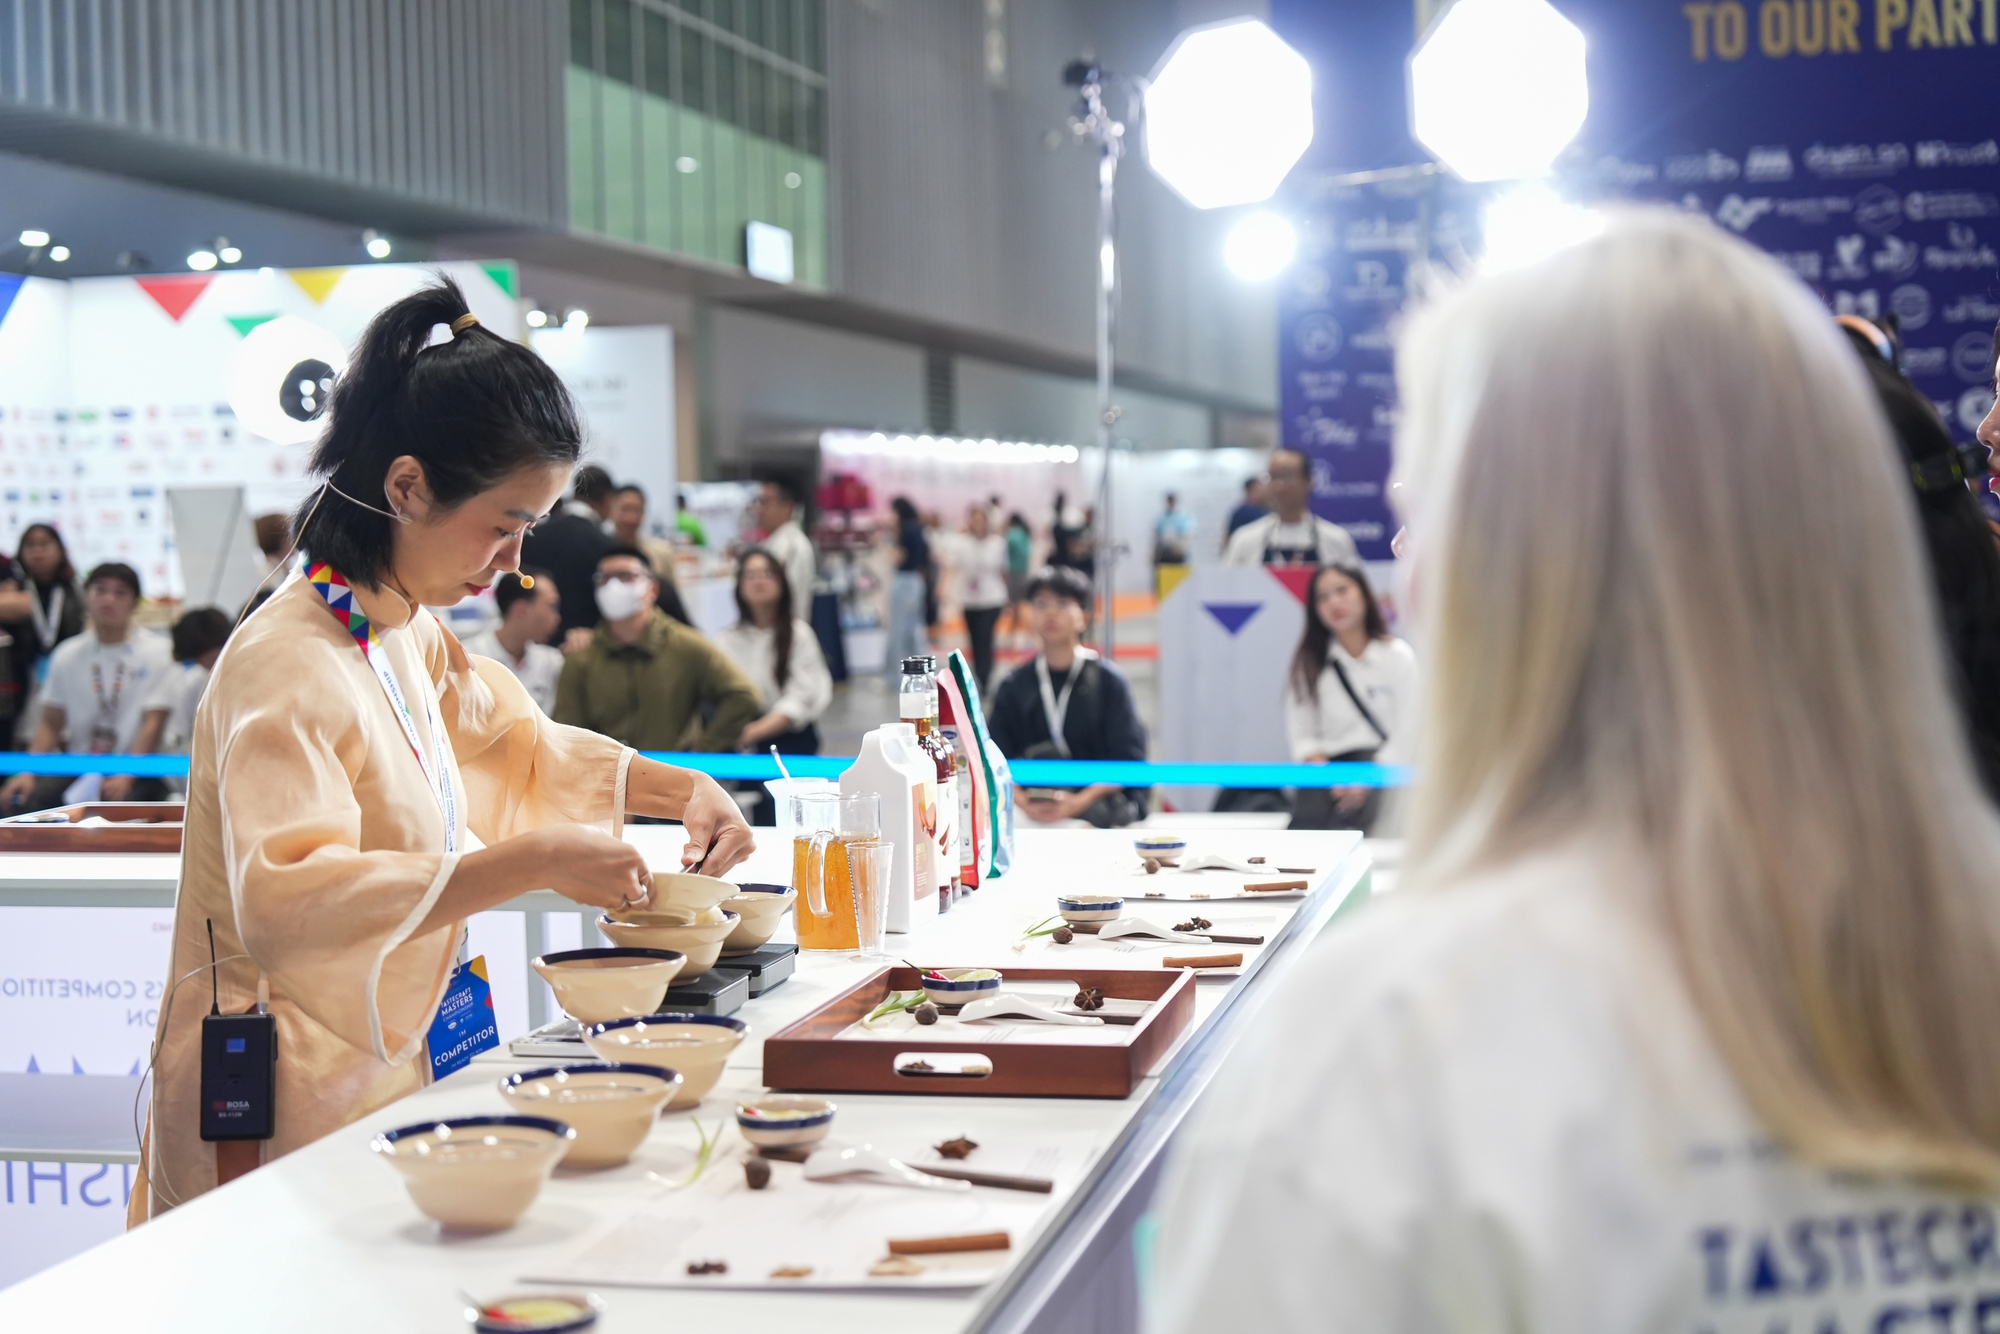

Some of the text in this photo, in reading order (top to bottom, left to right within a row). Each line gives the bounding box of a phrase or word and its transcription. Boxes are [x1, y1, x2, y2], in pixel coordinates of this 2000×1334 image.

[1682, 1, 1747, 60] TO
[1758, 0, 1862, 56] OUR
[441, 987, 471, 1008] TASTECRAFT
[442, 993, 473, 1017] MASTERS
[434, 1026, 495, 1066] COMPETITOR
